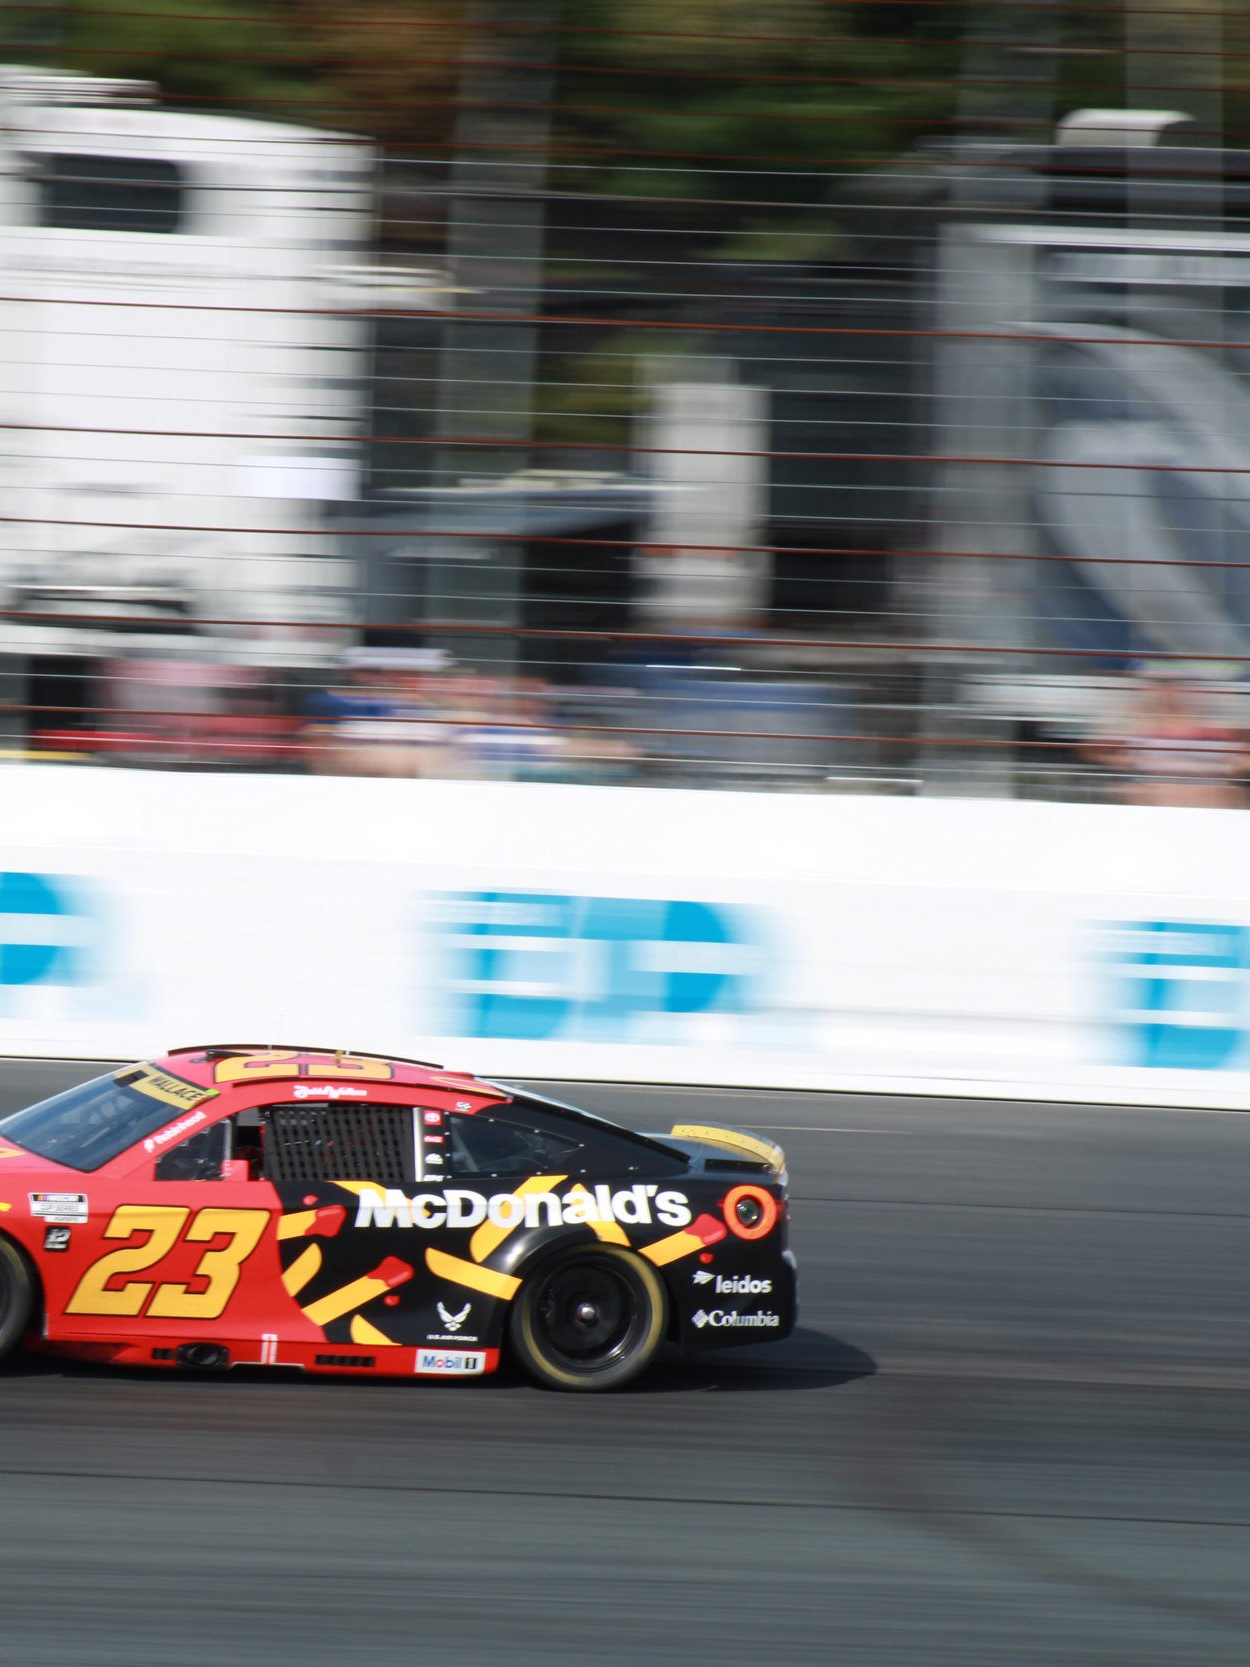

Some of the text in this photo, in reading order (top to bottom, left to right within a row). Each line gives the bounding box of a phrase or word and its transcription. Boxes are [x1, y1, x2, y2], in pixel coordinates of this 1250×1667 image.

[213, 1051, 395, 1084] 23
[149, 1076, 205, 1102] WALLACE
[354, 1184, 692, 1229] McDonald's
[63, 1203, 271, 1320] 23
[715, 1274, 772, 1293] leidos
[708, 1310, 779, 1327] Columbia
[423, 1355, 462, 1368] Mobil
